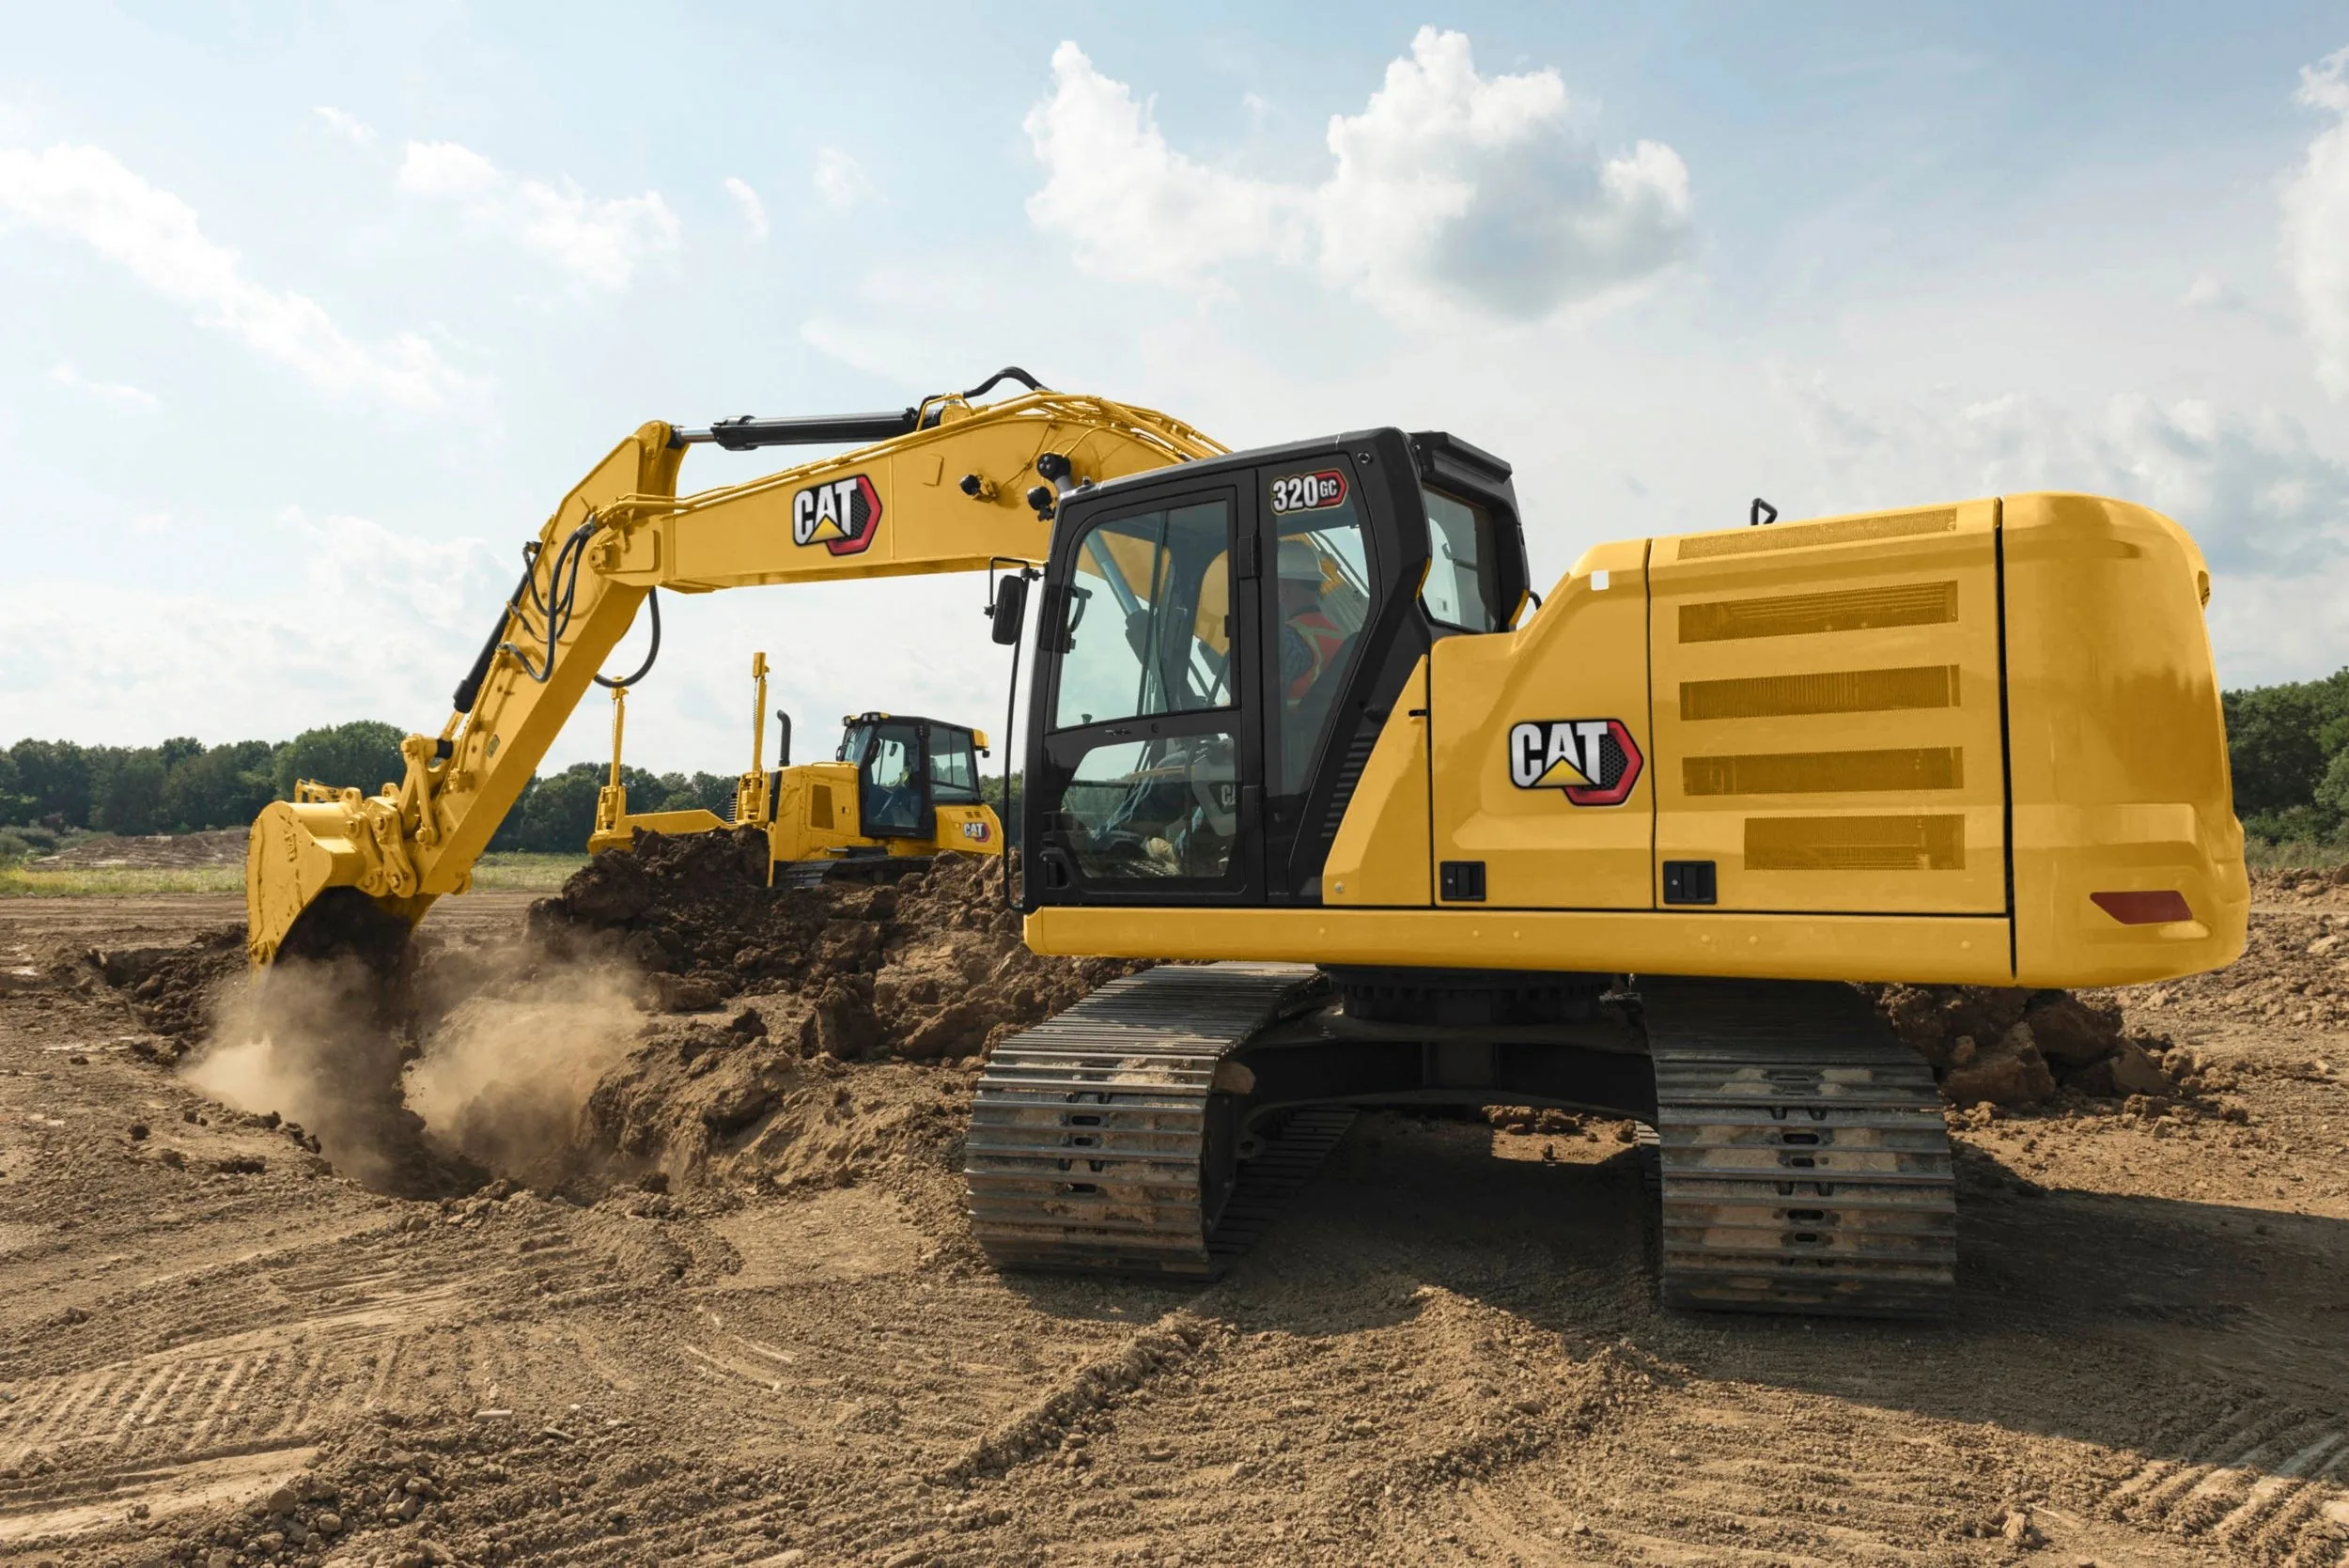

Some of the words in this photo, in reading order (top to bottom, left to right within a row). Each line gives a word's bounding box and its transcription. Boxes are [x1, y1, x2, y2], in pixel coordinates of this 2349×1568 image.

[794, 477, 857, 545] CAT
[1272, 475, 1318, 511] 320
[1319, 479, 1338, 497] GC
[1511, 722, 1608, 787] CAT
[963, 823, 984, 837] CAT
